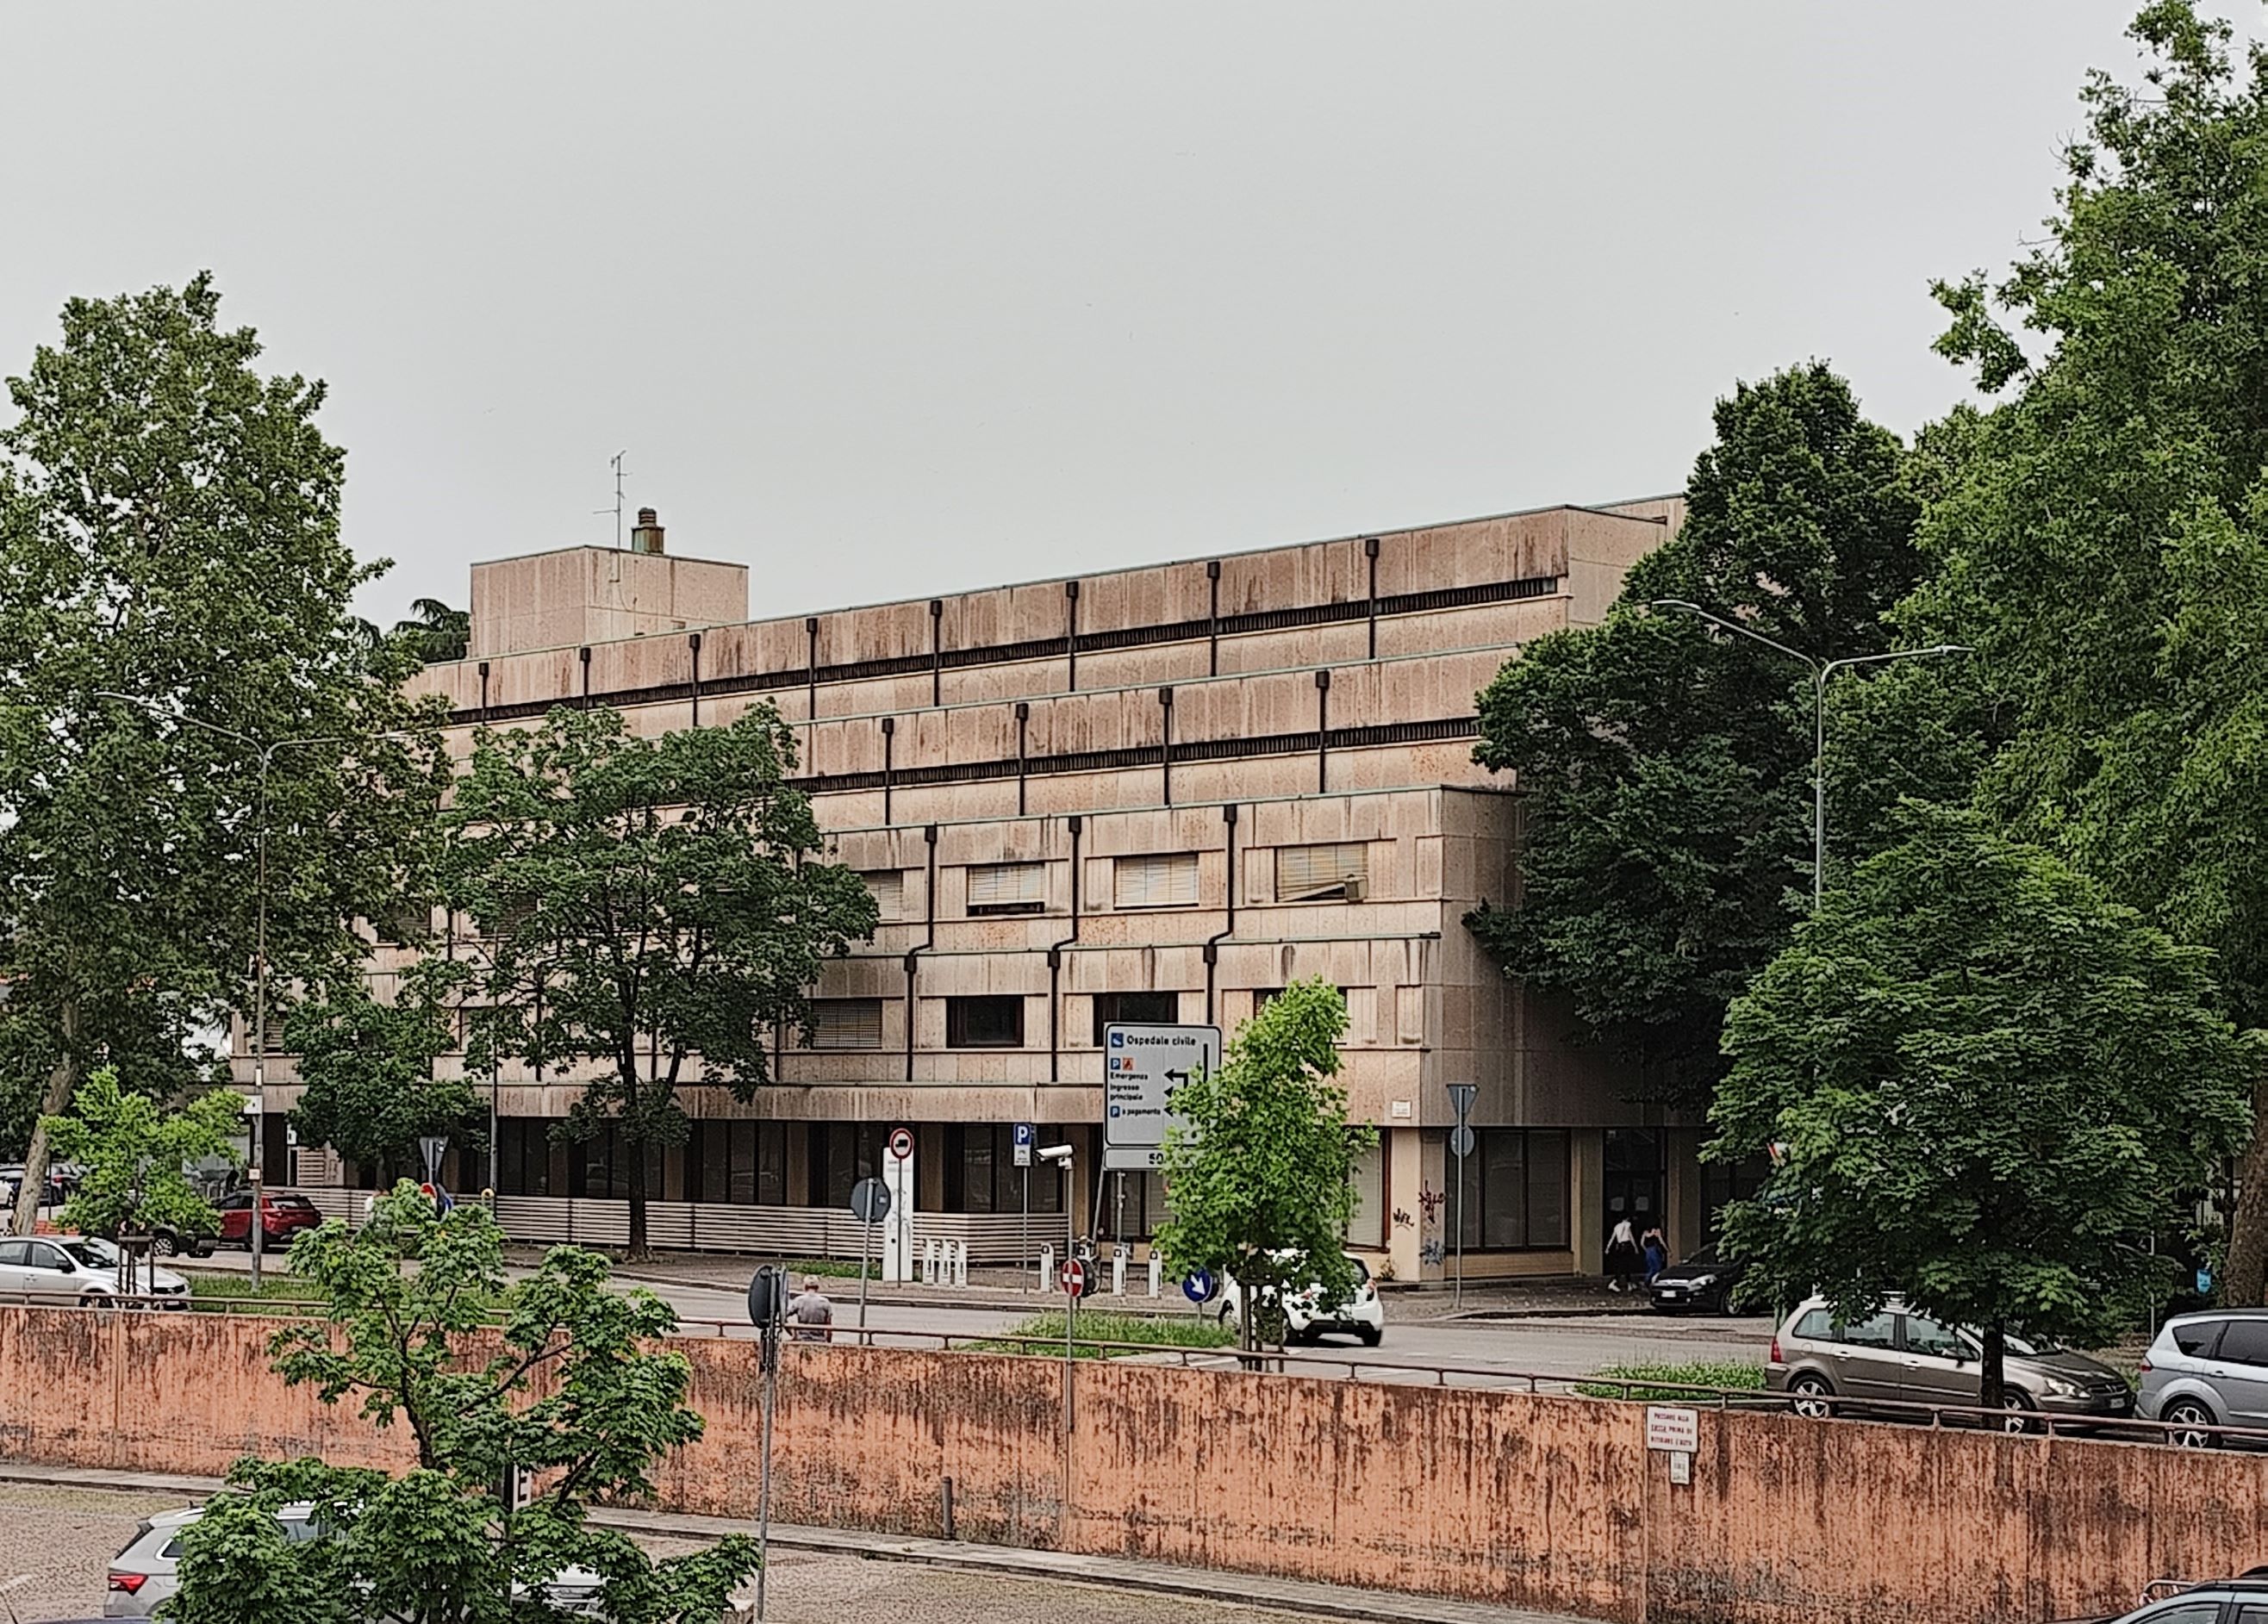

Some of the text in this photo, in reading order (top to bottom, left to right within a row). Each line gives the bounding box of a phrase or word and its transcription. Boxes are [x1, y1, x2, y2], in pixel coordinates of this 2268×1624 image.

[1126, 1035, 1196, 1046] Ospedale civile
[1110, 1072, 1149, 1081] Emergenza
[1110, 1083, 1140, 1092] Ingresso
[1110, 1093, 1143, 1102] principale
[1127, 1108, 1162, 1117] pagamento
[1017, 1125, 1029, 1144] P
